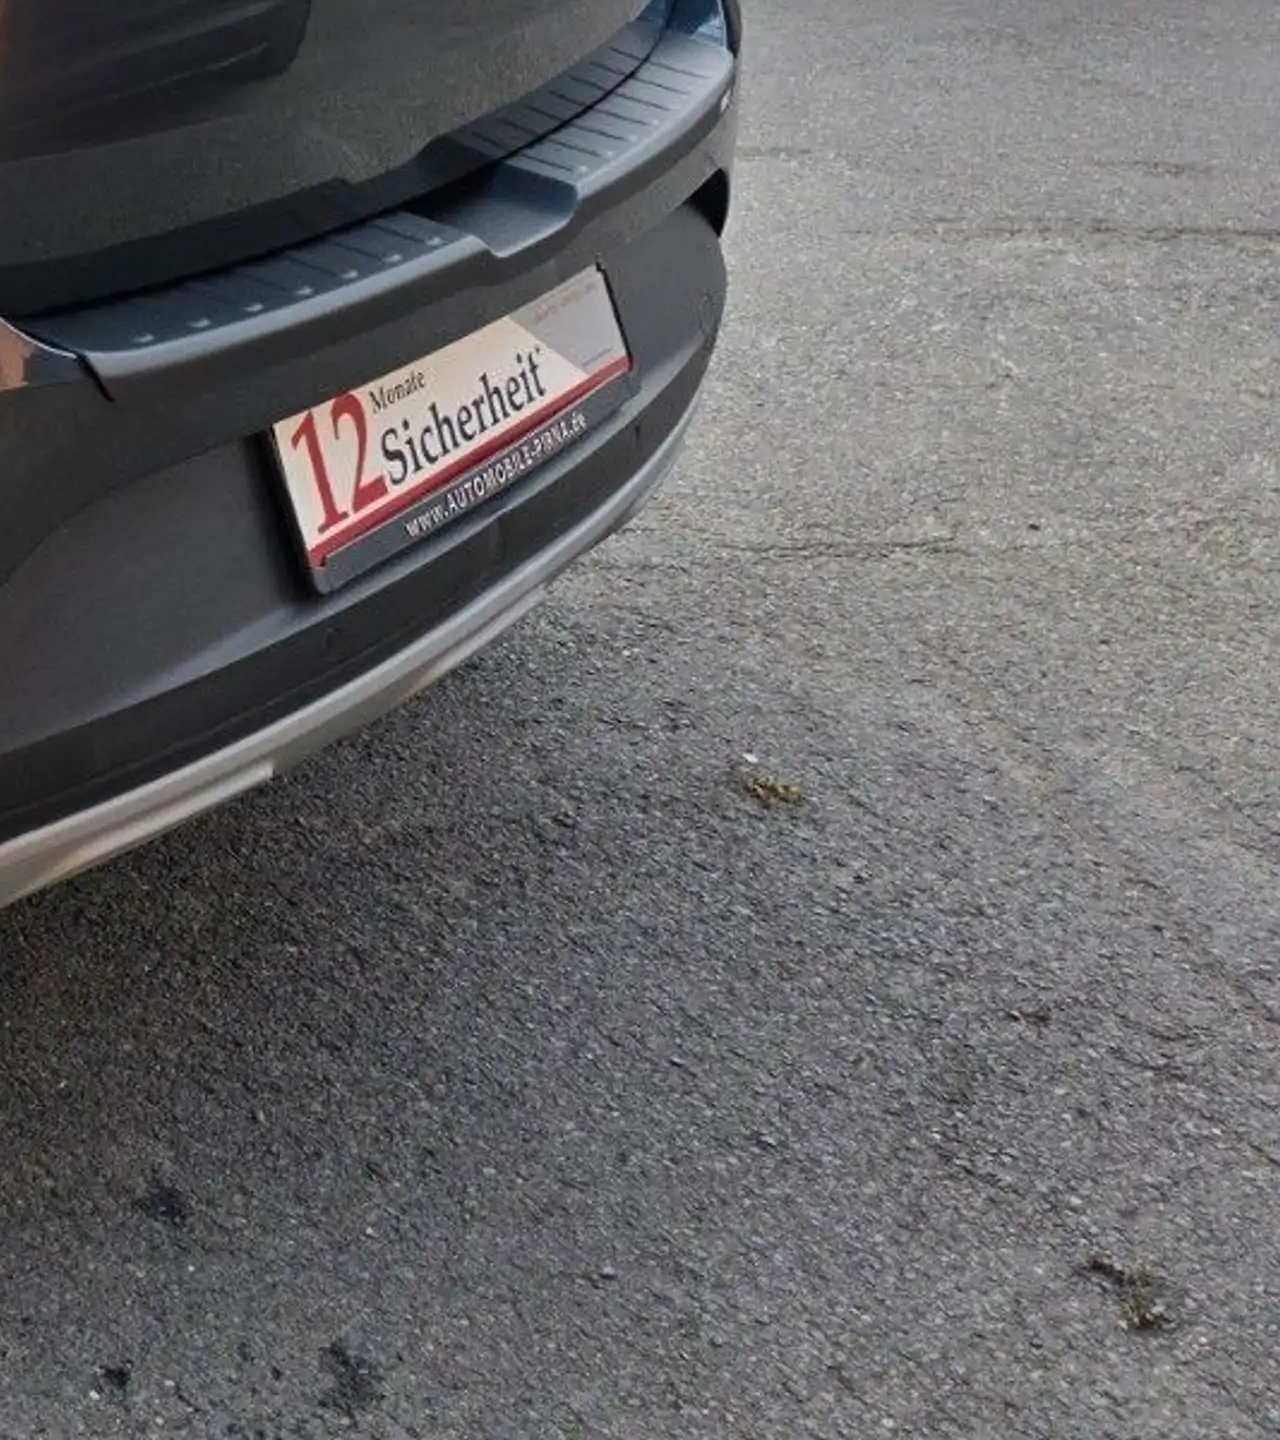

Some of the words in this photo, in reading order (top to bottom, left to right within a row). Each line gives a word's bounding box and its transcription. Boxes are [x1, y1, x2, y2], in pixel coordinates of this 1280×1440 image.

[368, 369, 427, 414] Monate
[380, 349, 547, 486] Sicherheit
[291, 392, 388, 535] 12
